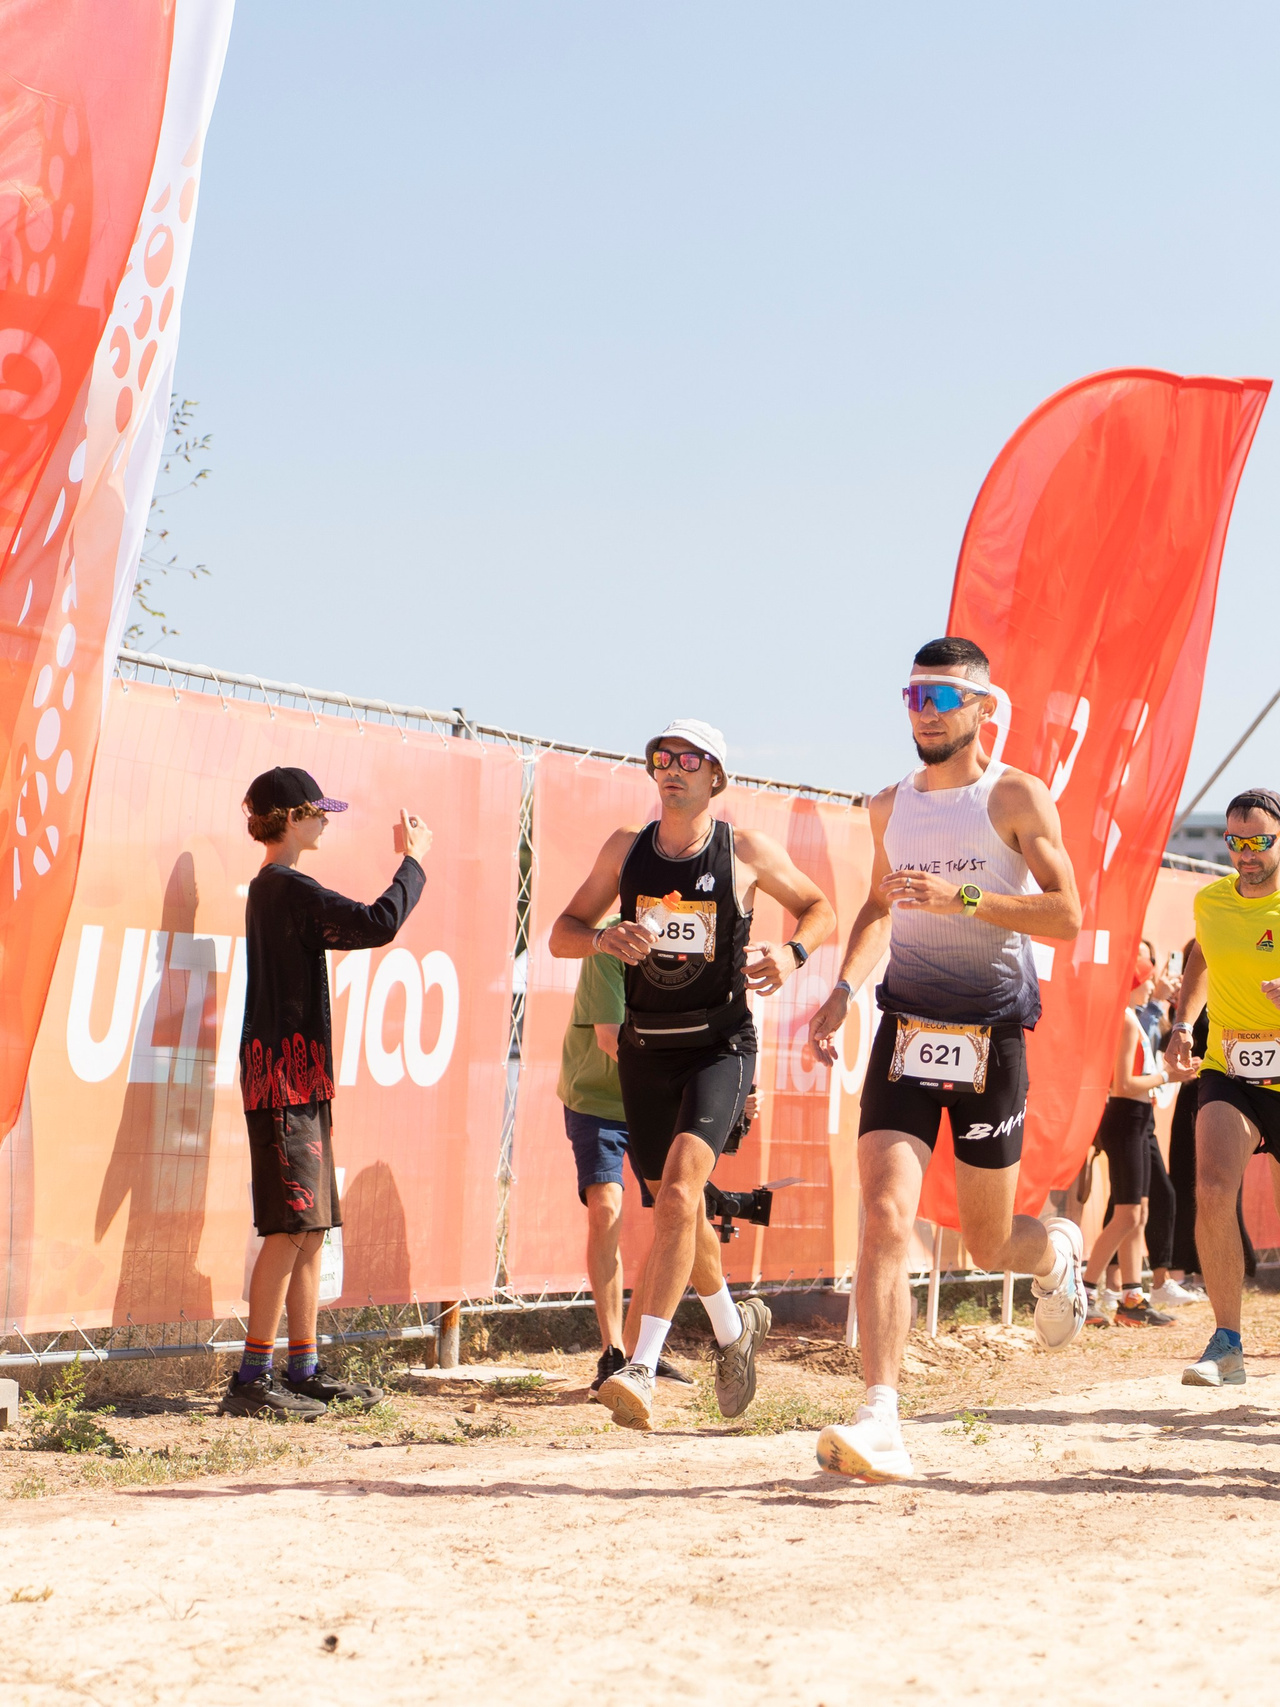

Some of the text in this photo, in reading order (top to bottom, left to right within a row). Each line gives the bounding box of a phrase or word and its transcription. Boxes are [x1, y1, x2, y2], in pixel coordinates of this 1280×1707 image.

[945, 858, 987, 873] TRUST
[66, 924, 460, 1087] ULT100
[1237, 1032, 1261, 1040] ПЕСОК
[919, 1042, 961, 1067] 621
[1238, 1049, 1276, 1067] 637
